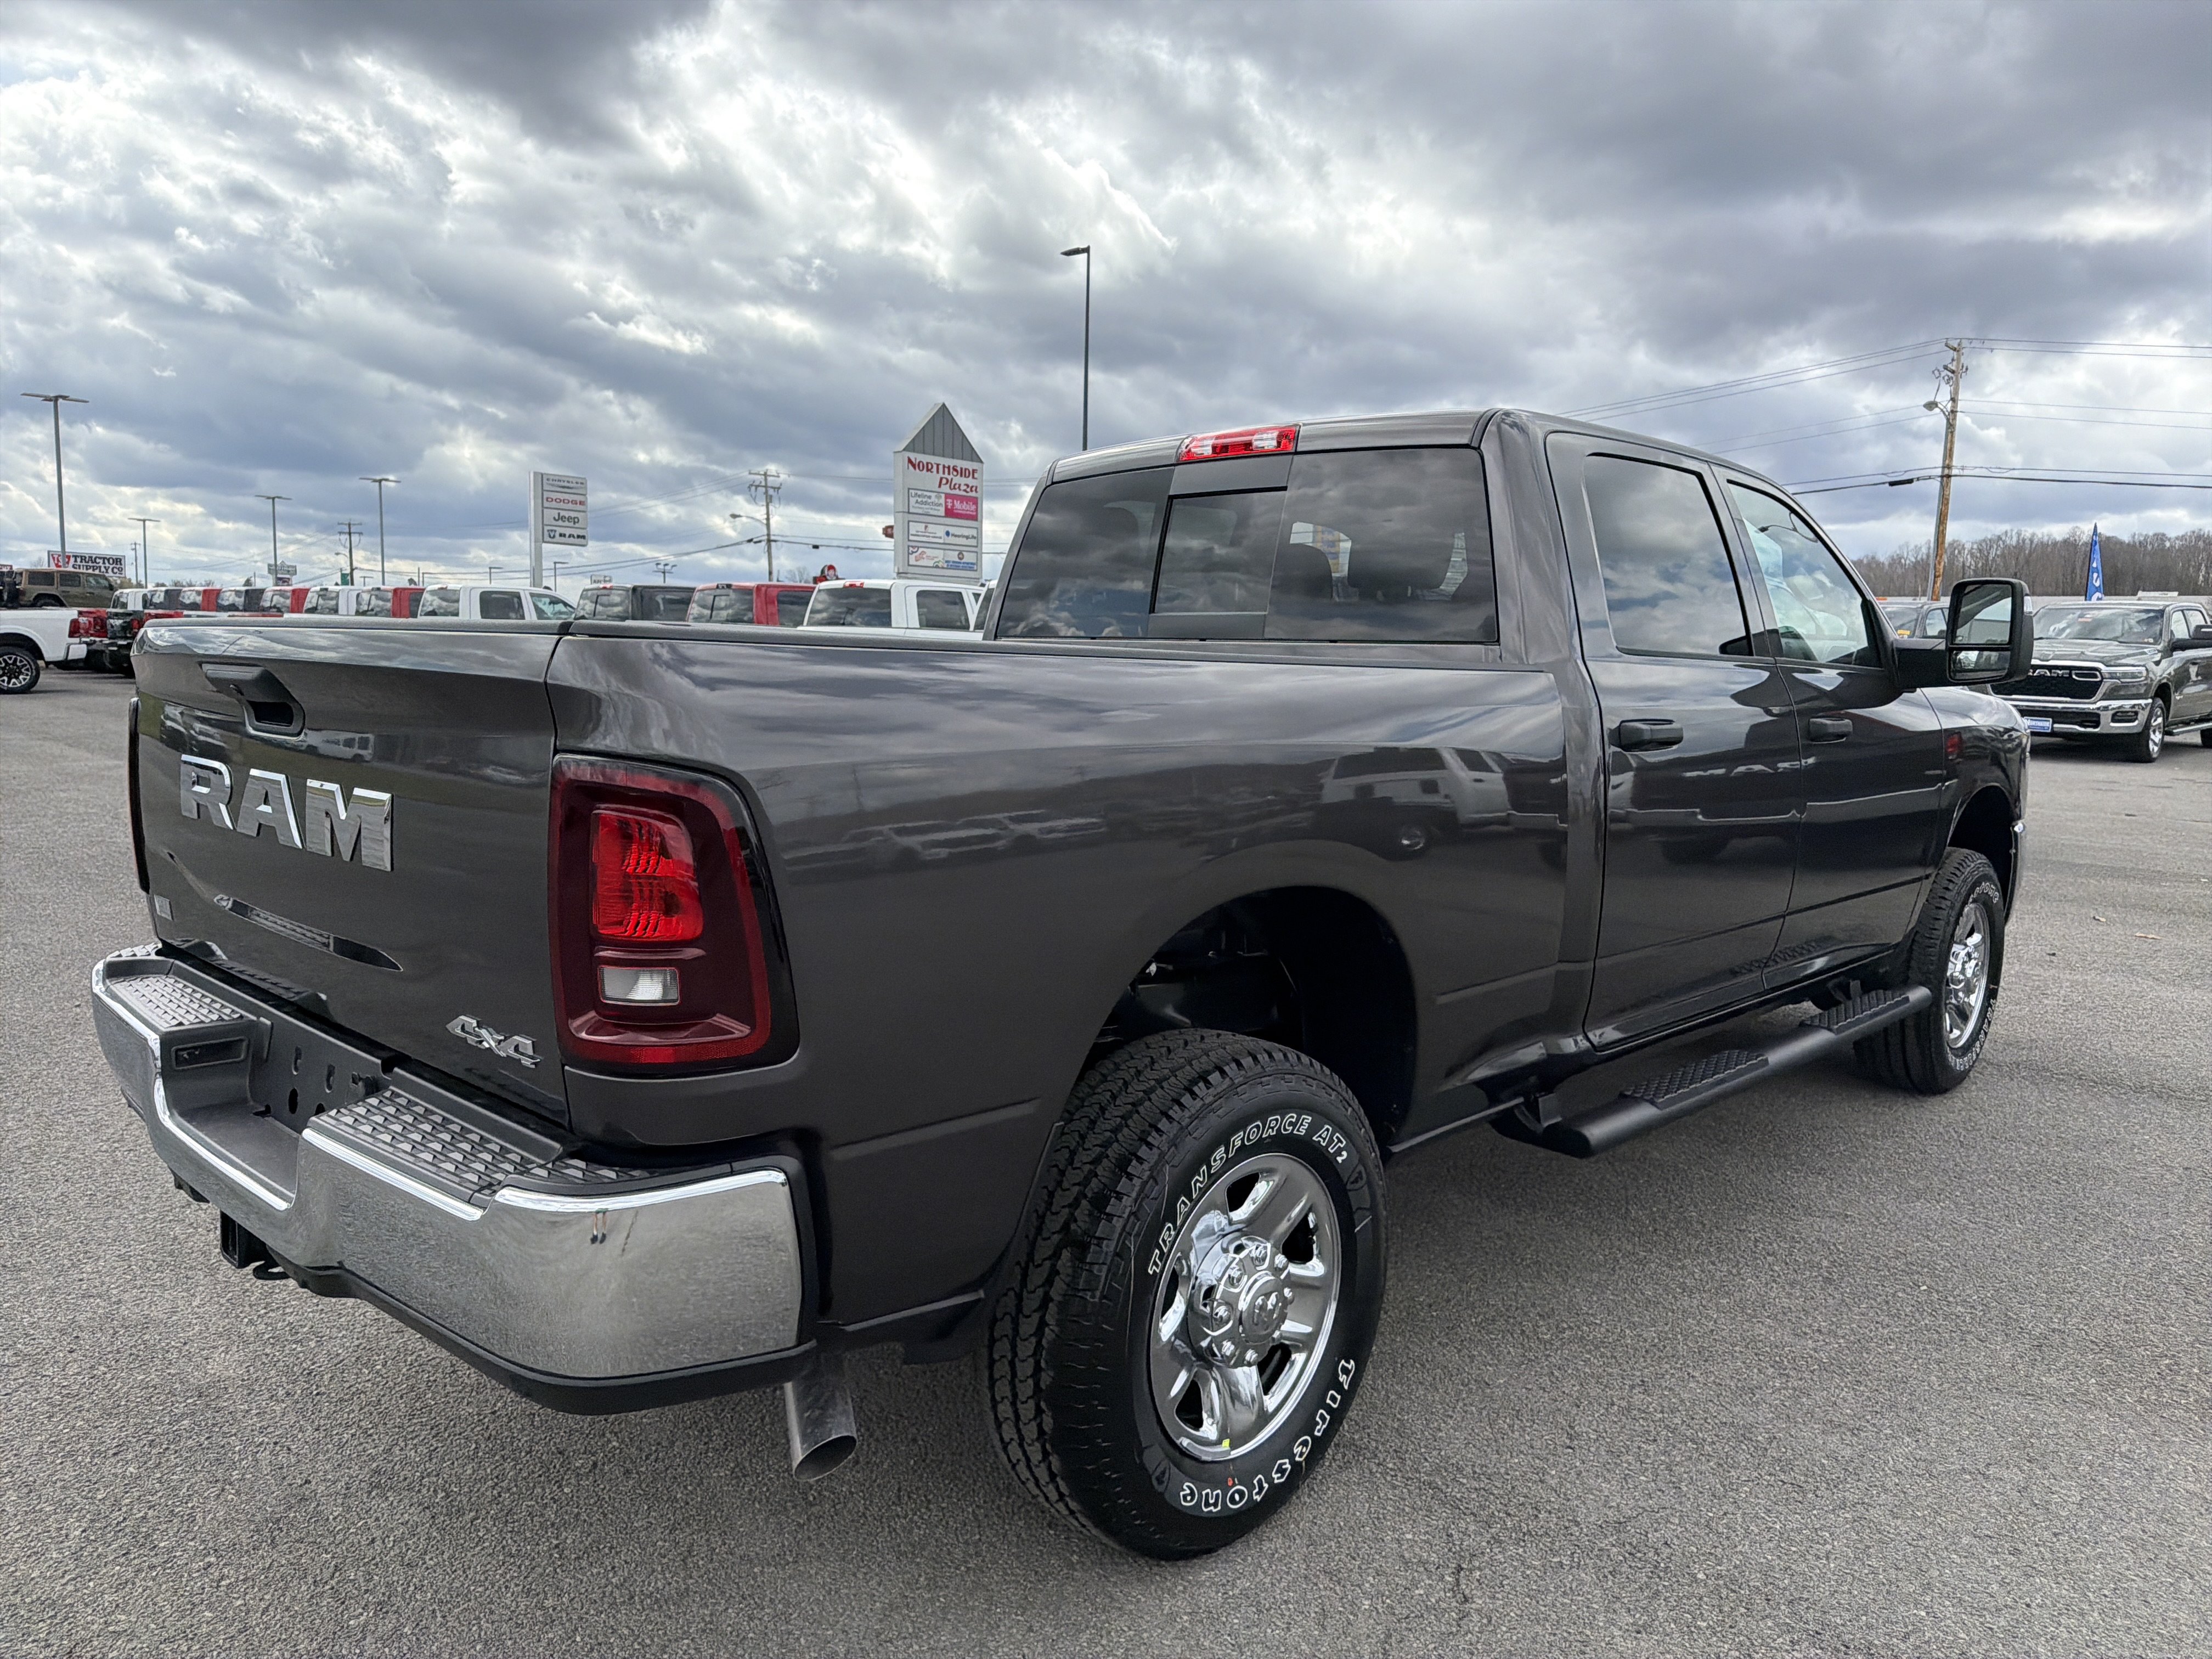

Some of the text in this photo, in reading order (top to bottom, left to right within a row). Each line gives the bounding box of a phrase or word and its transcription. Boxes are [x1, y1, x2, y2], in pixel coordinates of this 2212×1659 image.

[907, 456, 978, 479] NORTHSIDE
[938, 477, 978, 493] Plaza
[546, 497, 585, 506] DODGE
[915, 499, 943, 507] Addiction
[553, 512, 580, 525] Jeep
[72, 555, 123, 566] TRACTOR
[72, 564, 110, 574] SUPPLY
[180, 754, 393, 872] RAM
[1148, 1113, 1312, 1275] TRANSFORCE
[1180, 1359, 1355, 1511] Firestone
